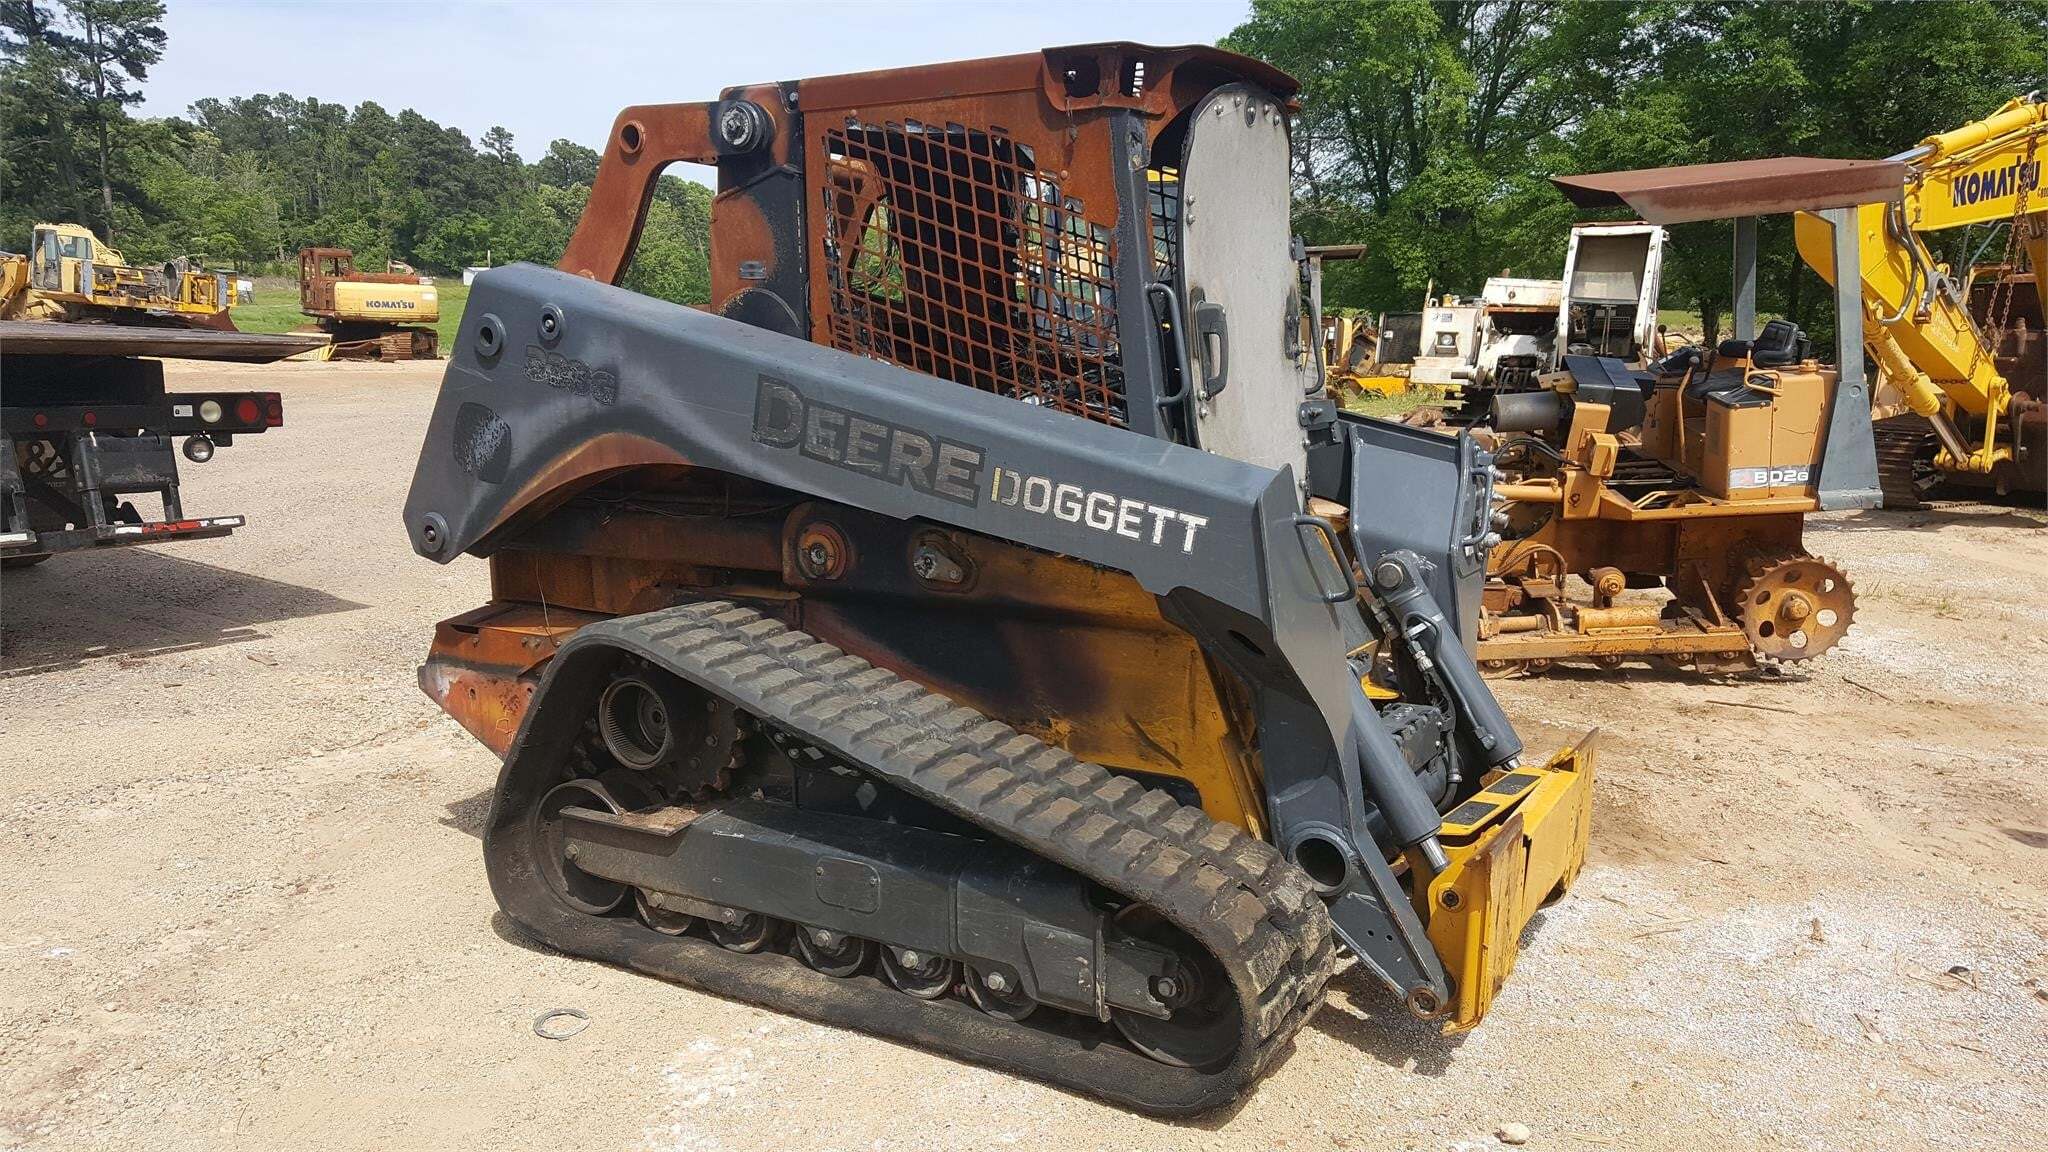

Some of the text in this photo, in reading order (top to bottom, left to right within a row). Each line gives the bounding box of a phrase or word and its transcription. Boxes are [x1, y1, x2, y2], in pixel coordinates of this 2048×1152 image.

[366, 300, 415, 309] KOMATSU
[752, 373, 987, 509] DEERE
[991, 466, 1209, 554] DOGGETT
